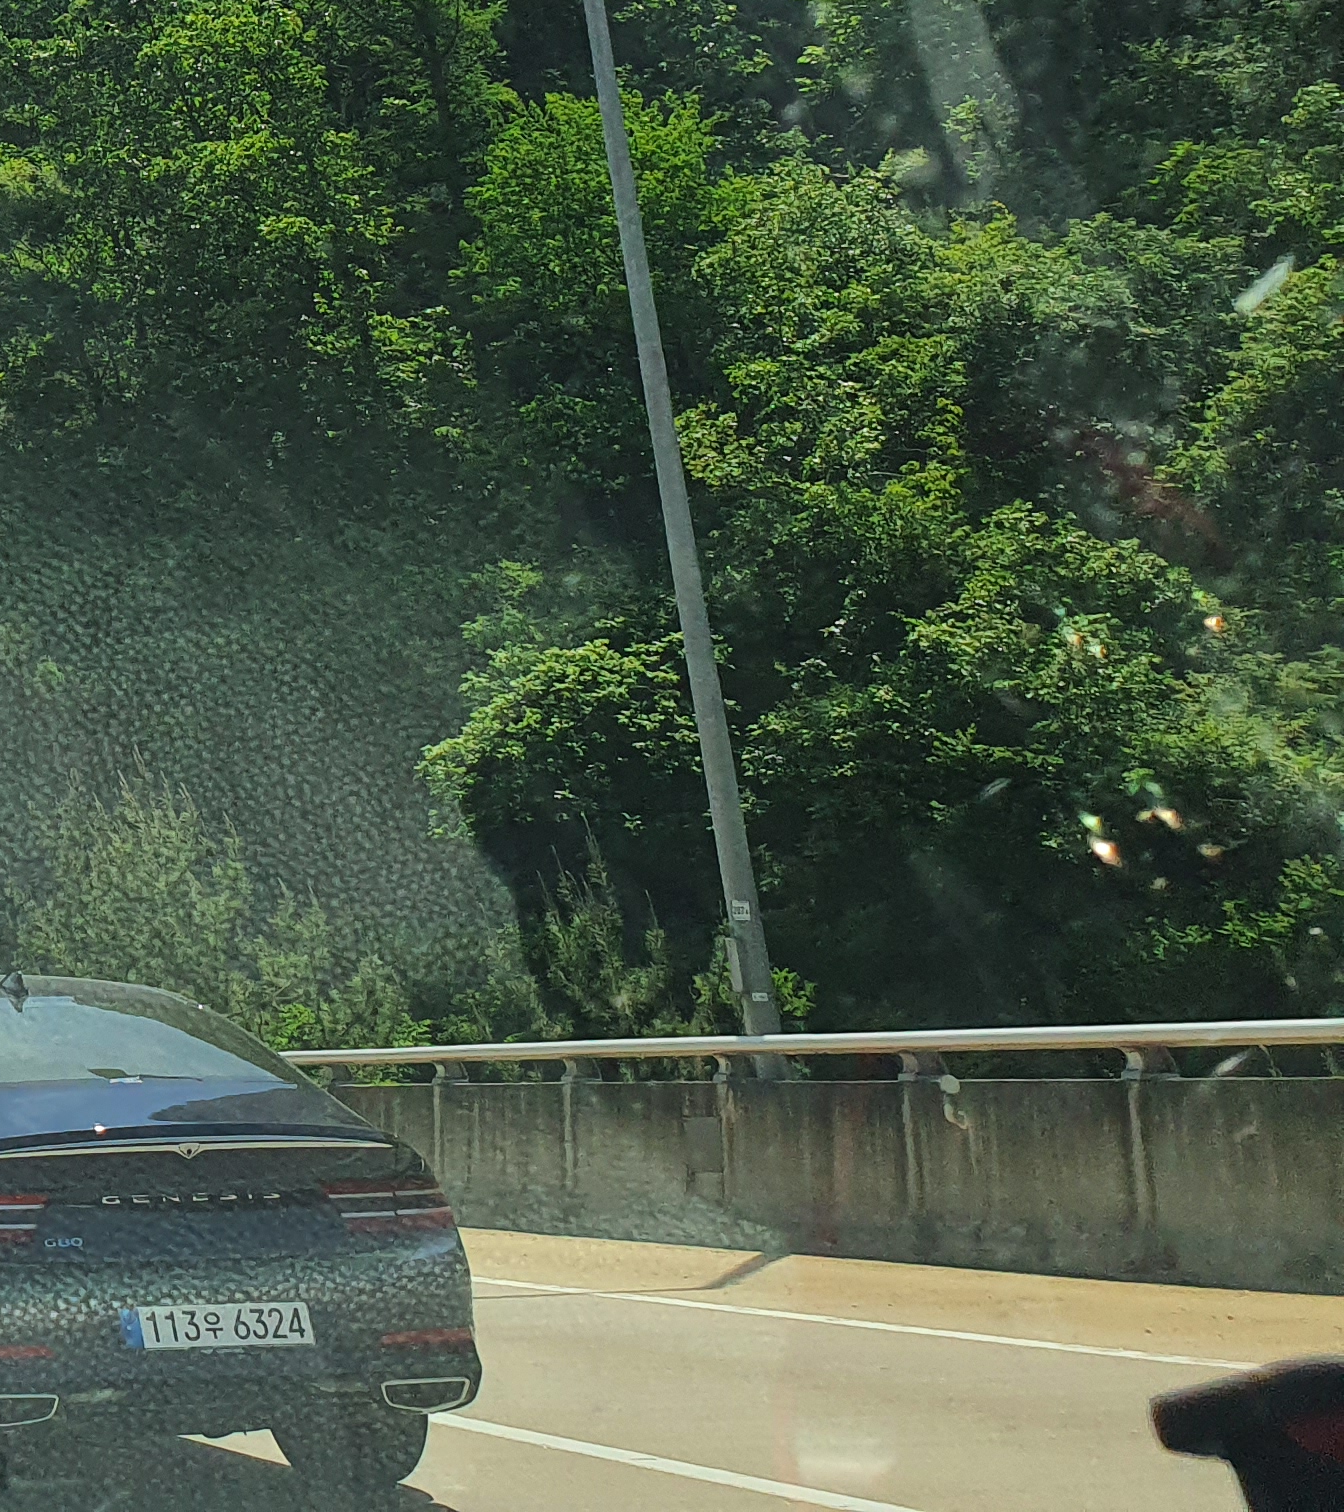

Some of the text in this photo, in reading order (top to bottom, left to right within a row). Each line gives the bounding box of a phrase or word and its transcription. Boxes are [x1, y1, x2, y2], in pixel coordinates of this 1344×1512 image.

[100, 1191, 282, 1205] GENESIS
[145, 1307, 306, 1343] 113우 6324
